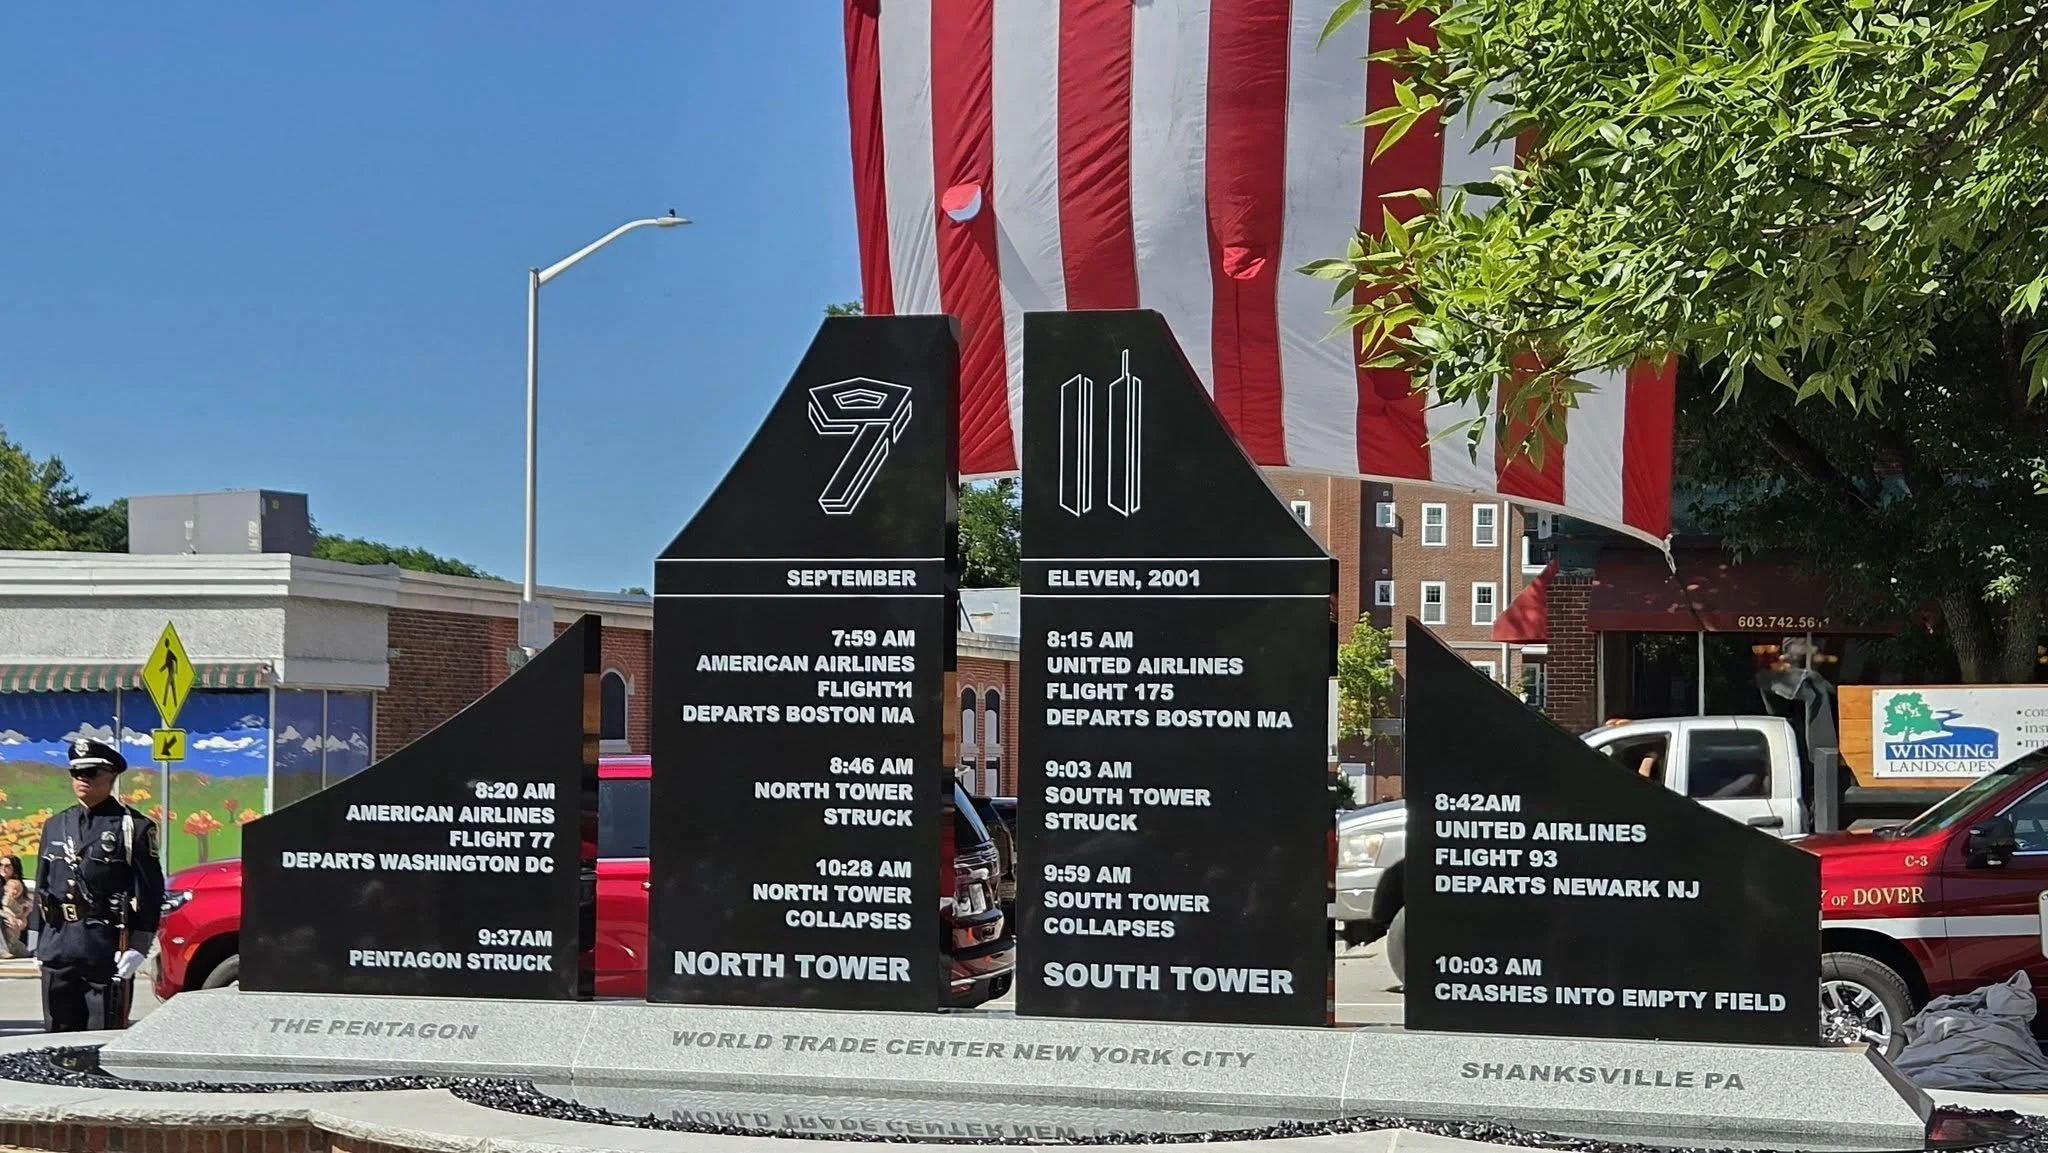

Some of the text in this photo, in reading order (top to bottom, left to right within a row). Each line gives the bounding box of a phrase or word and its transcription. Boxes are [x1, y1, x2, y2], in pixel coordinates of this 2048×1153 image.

[786, 569, 917, 587] SEPTEMBER
[1048, 569, 1200, 590] ELEVEN, 2001
[831, 629, 916, 648] 7:59 AM
[1046, 630, 1134, 649] 8:15 AM
[696, 654, 916, 673] AMERICAN AIRLINES
[1047, 656, 1244, 675] UNITED AIRLINES
[1046, 682, 1175, 701] FLIGHT 175
[682, 704, 915, 724] DEPARTS BOSTON MA
[1046, 708, 1293, 729] DEPARTS BOSTON MA
[1890, 744, 1994, 758] WINNING
[829, 756, 914, 776] 8:46 AM
[1045, 760, 1132, 779] 9:03 AM
[1890, 761, 1996, 772] LANDSCAPES
[474, 781, 556, 801] 8:20 AM
[754, 781, 914, 801] NORTH TOWER
[1044, 786, 1212, 807] SOUTH TOWER
[1434, 793, 1521, 813] 8:42AM
[345, 804, 556, 825] AMERICAN AIRLINES
[823, 807, 913, 827] STRUCK
[1044, 812, 1138, 832] STRUCK
[449, 830, 555, 850] FLIGHT 77
[1435, 820, 1647, 843] UNITED AIRLINES
[282, 851, 555, 874] DEPARTS WASHINGTON DC
[1435, 847, 1558, 868] FLIGHT 93
[1904, 855, 1929, 868] C-3
[815, 858, 912, 879] 10:28 AM
[1044, 864, 1131, 884] 9:59 AM
[752, 883, 913, 905] NORTH TOWER
[1435, 874, 1700, 899] DEPARTS NEWARK NJ
[1831, 895, 1849, 907] OF
[1852, 886, 1925, 906] DOVER
[1043, 890, 1211, 913] SOUTH TOWER
[785, 909, 912, 930] COLLAPSES
[1043, 916, 1175, 938] COLLAPSES
[478, 928, 553, 948] 9:37AM
[349, 949, 553, 972] PENTAGON STRUCK
[674, 950, 911, 982] NORTH TOWER
[1435, 955, 1542, 977] 10:03 AM
[1043, 961, 1294, 995] SOUTH TOWER
[1434, 982, 1786, 1012] CRASHES INTO EMPTY FIELD
[270, 1018, 479, 1039] THE PENTAGON
[672, 1031, 1256, 1067] WORLD TRADE CENTER NEW YORK CITY
[1460, 1063, 1745, 1090] SHANKSVILLE PA
